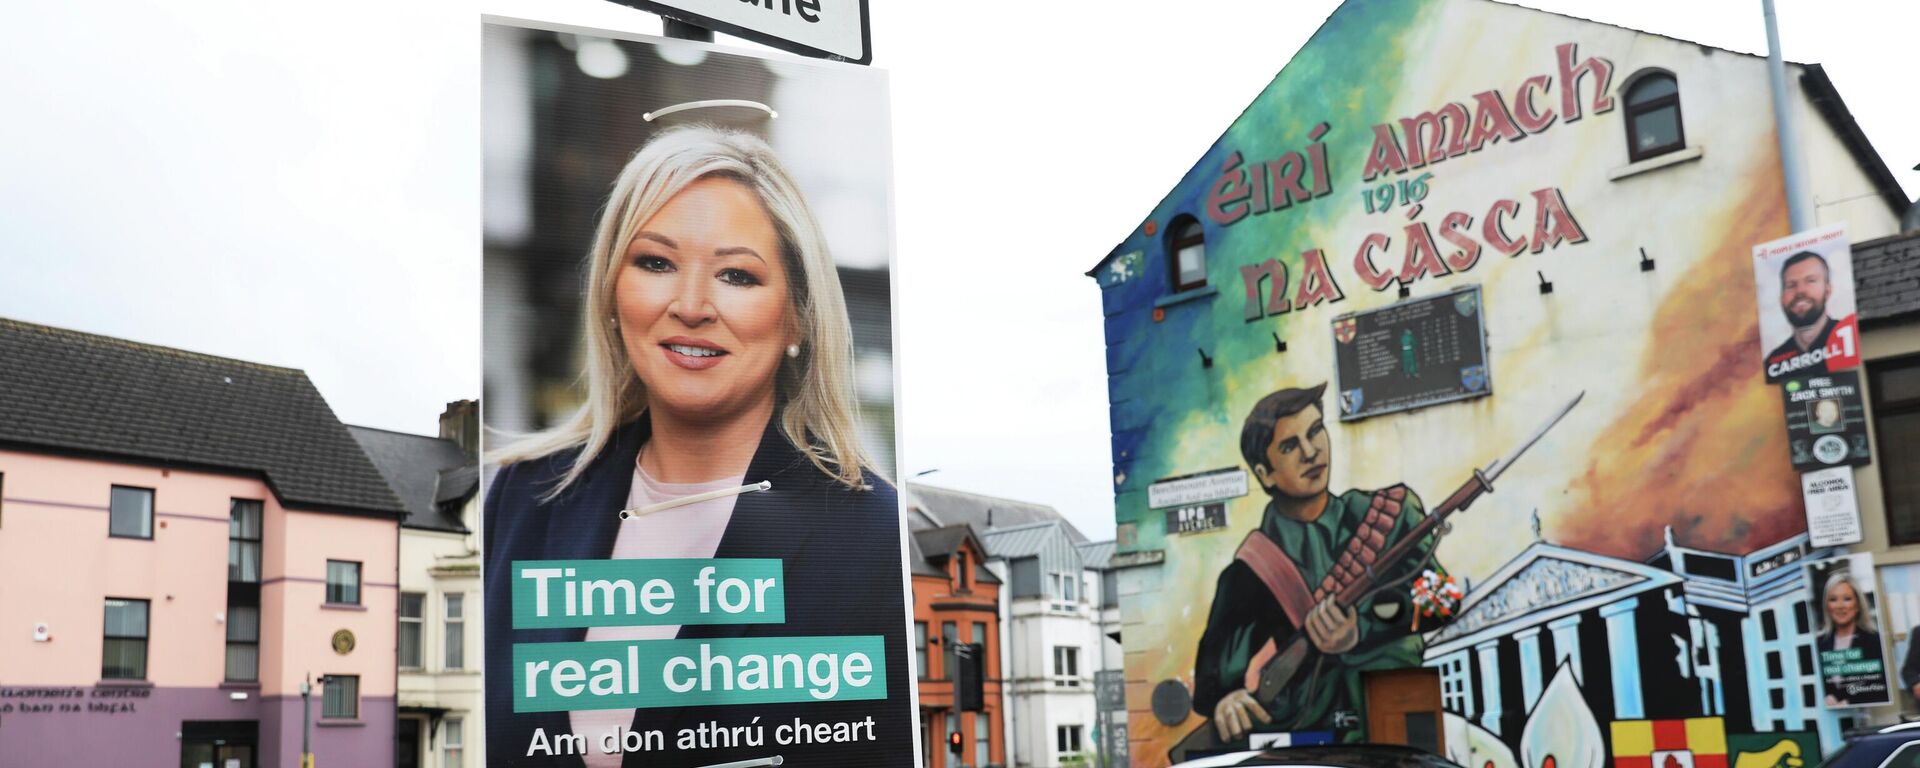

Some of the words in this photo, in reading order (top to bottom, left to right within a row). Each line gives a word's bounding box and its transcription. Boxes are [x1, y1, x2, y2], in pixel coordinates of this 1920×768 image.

[1361, 171, 1435, 215] 1916
[1353, 187, 1589, 292] CÁSCA
[1768, 343, 1842, 377] CARROLL
[1836, 325, 1856, 358] 1
[521, 567, 675, 617] Time
[694, 566, 776, 615] for
[525, 645, 640, 698] real
[662, 643, 873, 700] change
[1822, 651, 1844, 661] Time
[1846, 648, 1862, 660] for
[1824, 664, 1841, 675] real
[1842, 660, 1880, 673] change
[526, 727, 587, 757] Am
[599, 725, 664, 755] don
[676, 716, 764, 749] athrú
[774, 715, 876, 746] cheart
